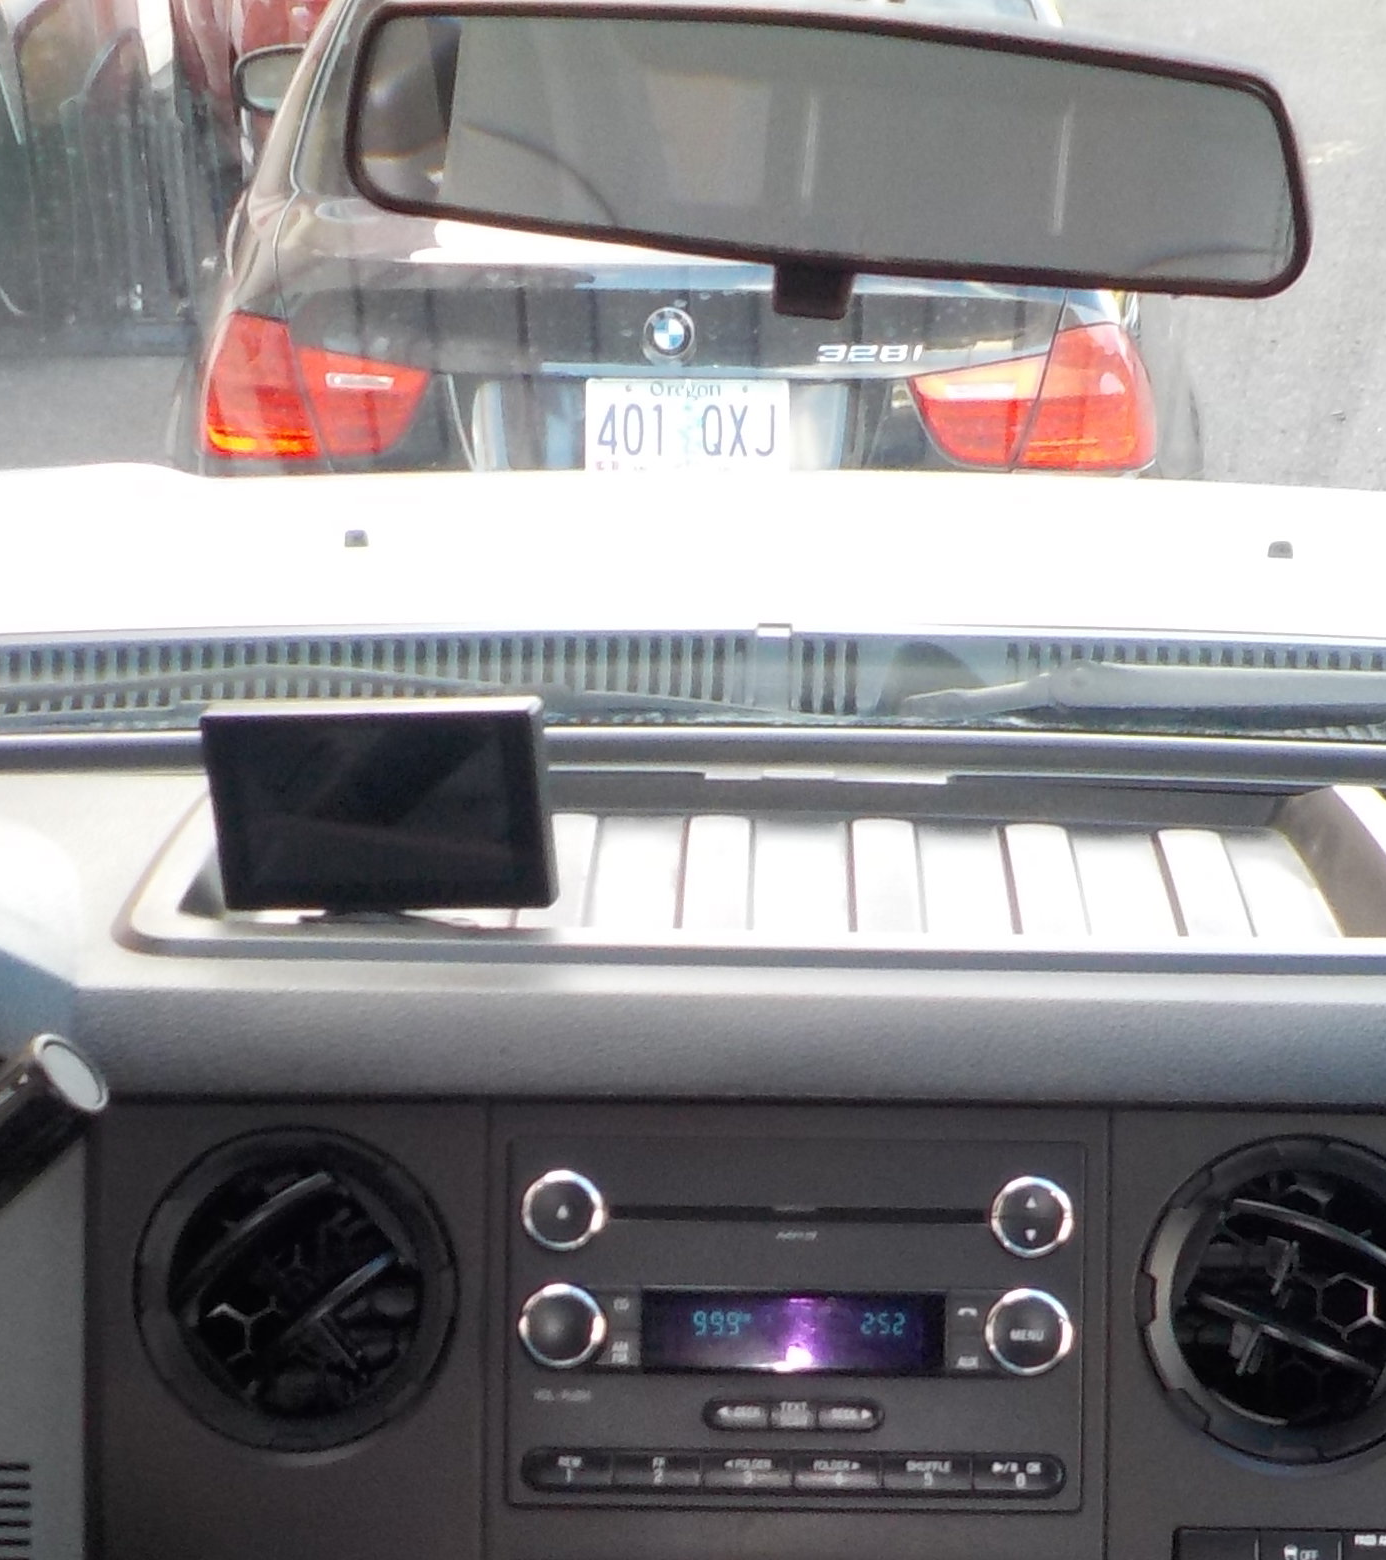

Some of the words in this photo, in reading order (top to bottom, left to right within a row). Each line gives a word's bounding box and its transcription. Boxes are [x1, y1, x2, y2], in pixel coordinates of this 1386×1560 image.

[649, 384, 722, 400] Oregon
[597, 403, 663, 456] 401
[701, 403, 776, 457] QXJ
[1010, 1328, 1045, 1343] MENU
[906, 1460, 951, 1473] SHUFFLE
